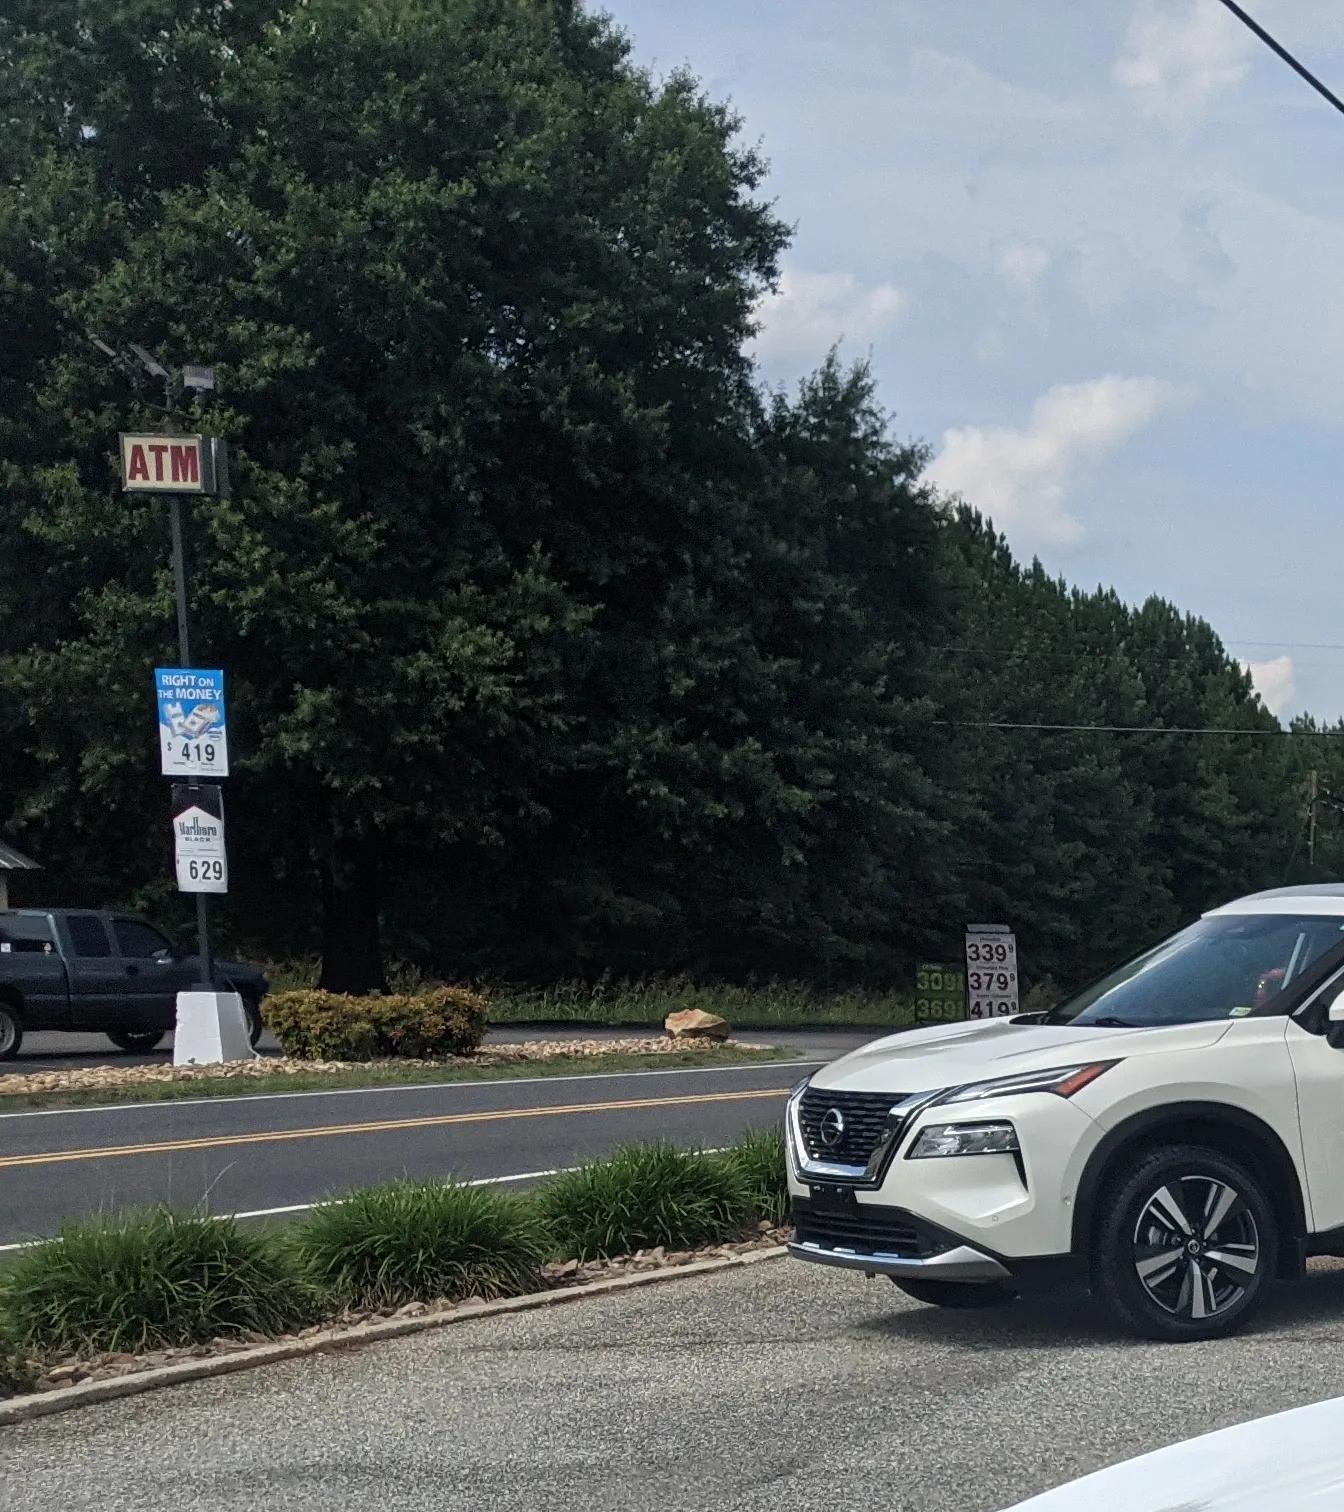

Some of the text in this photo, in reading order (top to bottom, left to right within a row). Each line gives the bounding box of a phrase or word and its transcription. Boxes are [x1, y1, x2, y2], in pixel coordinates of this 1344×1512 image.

[128, 444, 199, 482] ATM
[161, 674, 215, 687] RIGHT ON
[157, 688, 222, 700] THE MONEY
[181, 742, 215, 762] 419
[189, 860, 223, 880] 629
[968, 943, 1007, 961] 339
[969, 973, 1009, 990] 379
[971, 1001, 1010, 1018] 419
